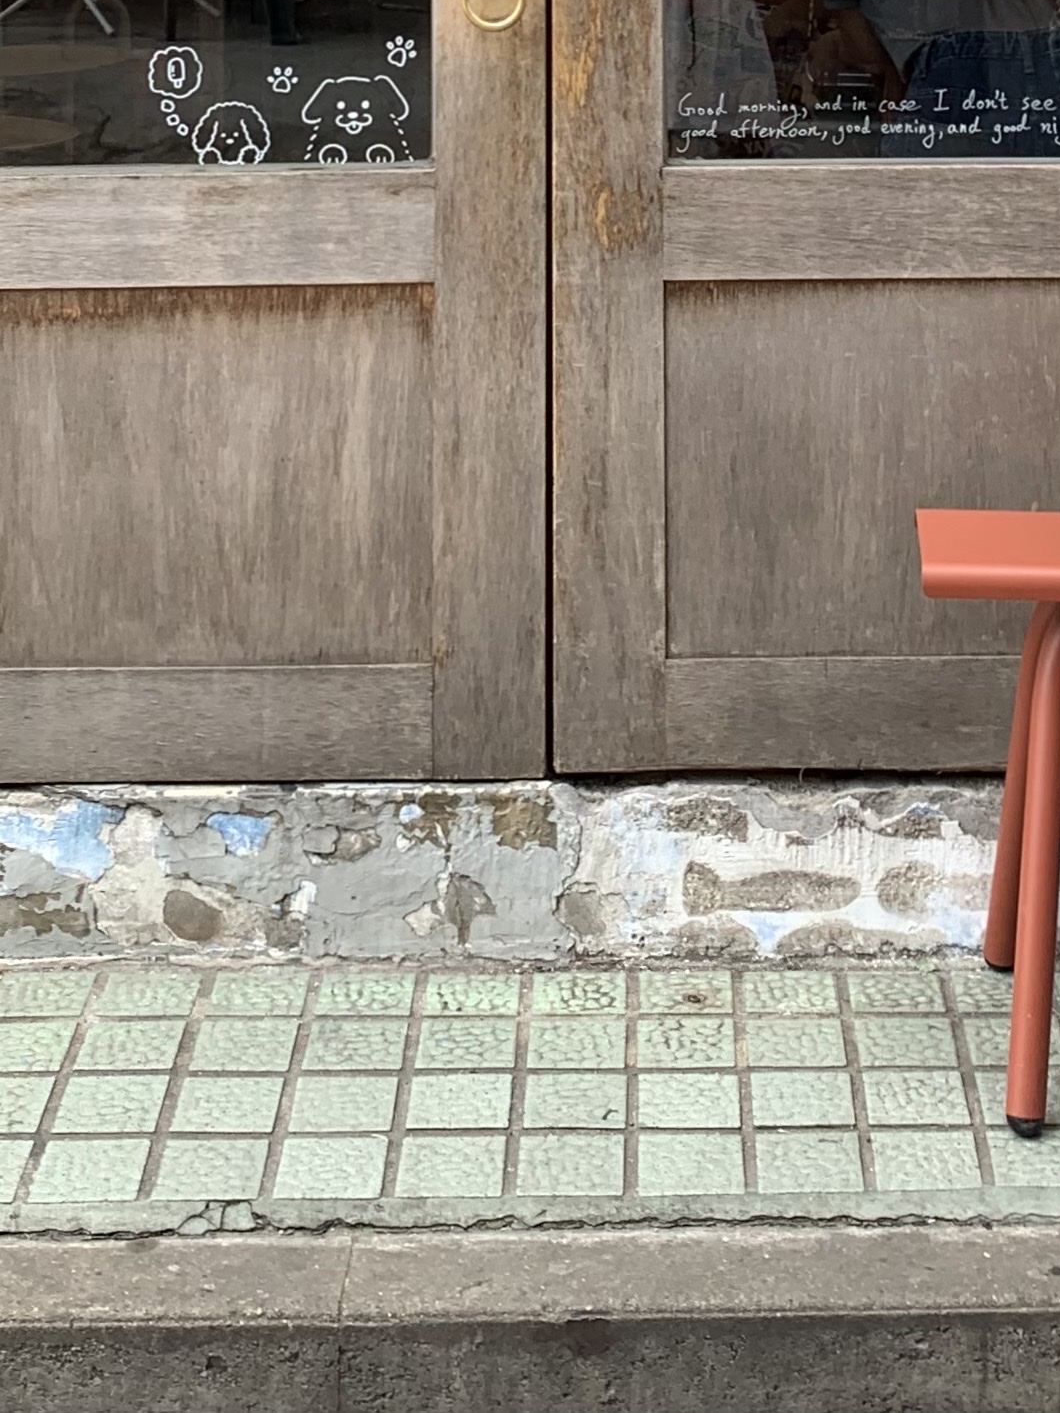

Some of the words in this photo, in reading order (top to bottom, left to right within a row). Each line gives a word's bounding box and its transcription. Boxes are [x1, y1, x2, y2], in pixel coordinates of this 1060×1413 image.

[678, 92, 728, 117] Good
[738, 99, 808, 130] morning,
[814, 93, 843, 111] and
[852, 96, 868, 111] in
[879, 98, 923, 113] case
[933, 88, 951, 112] I
[962, 88, 1010, 111] don't
[1021, 95, 1058, 112] see
[676, 119, 718, 153] good
[730, 118, 829, 141] afternoon,
[832, 114, 872, 146] good
[880, 118, 944, 149] evening,
[946, 115, 983, 134] and
[991, 112, 1032, 145] good
